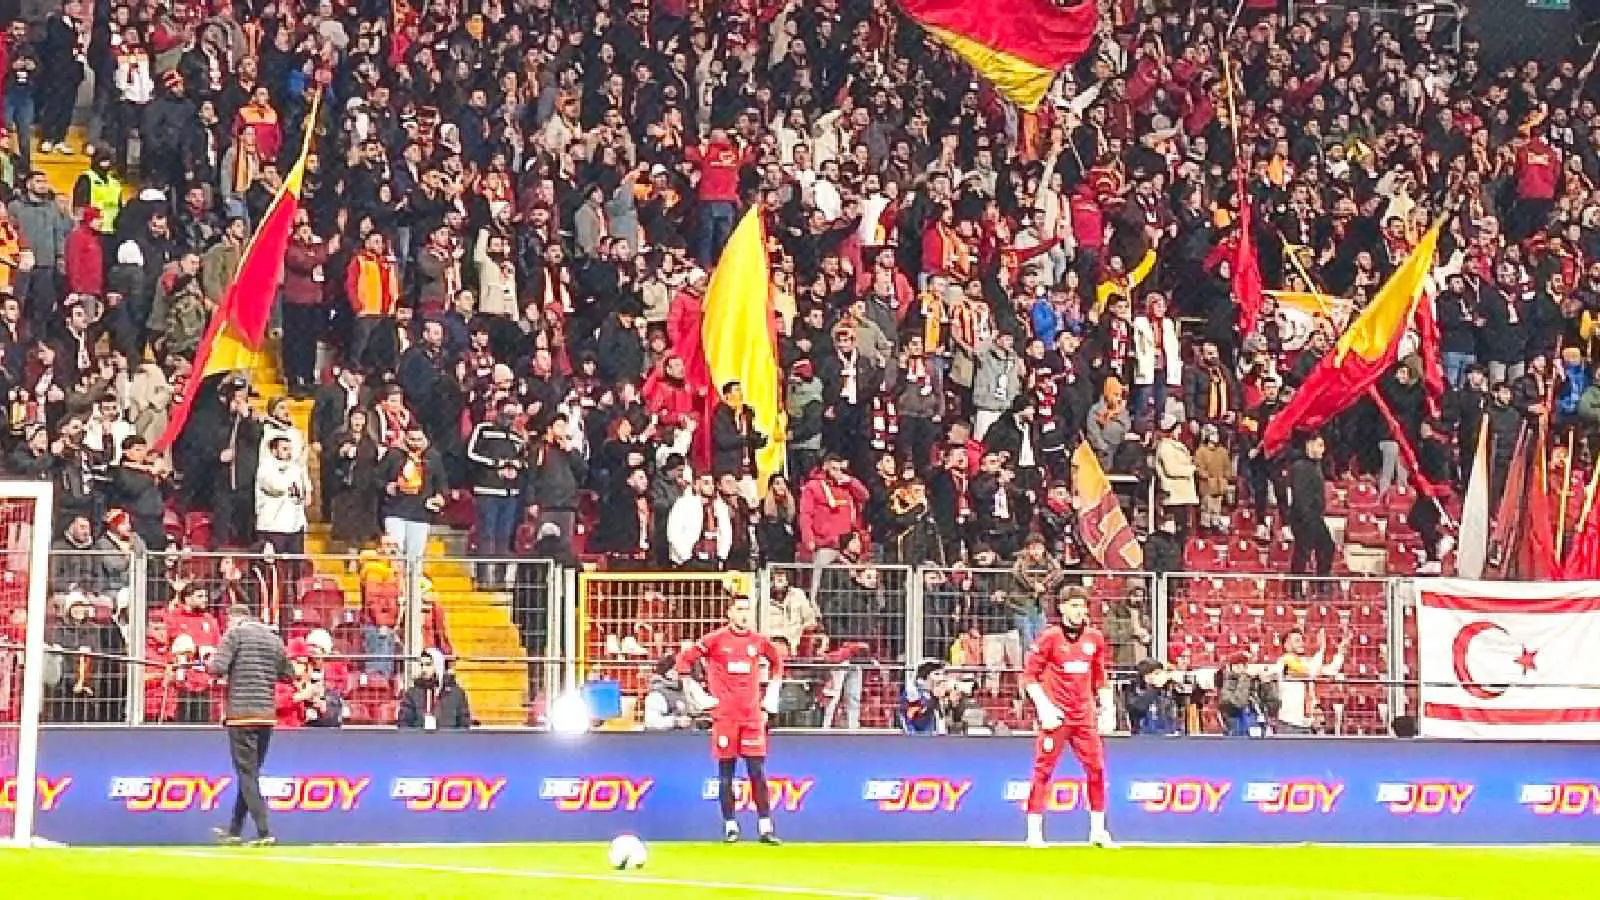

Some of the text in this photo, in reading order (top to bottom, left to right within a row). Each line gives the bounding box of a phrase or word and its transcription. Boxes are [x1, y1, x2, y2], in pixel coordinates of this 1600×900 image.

[126, 776, 231, 812] JOY
[268, 776, 371, 811] JOY
[406, 776, 507, 811] JOY
[556, 776, 656, 811] JOY
[879, 779, 973, 812] JOY
[1143, 781, 1232, 813] JOY
[1258, 781, 1344, 813] JOY
[1389, 782, 1474, 814] JOY
